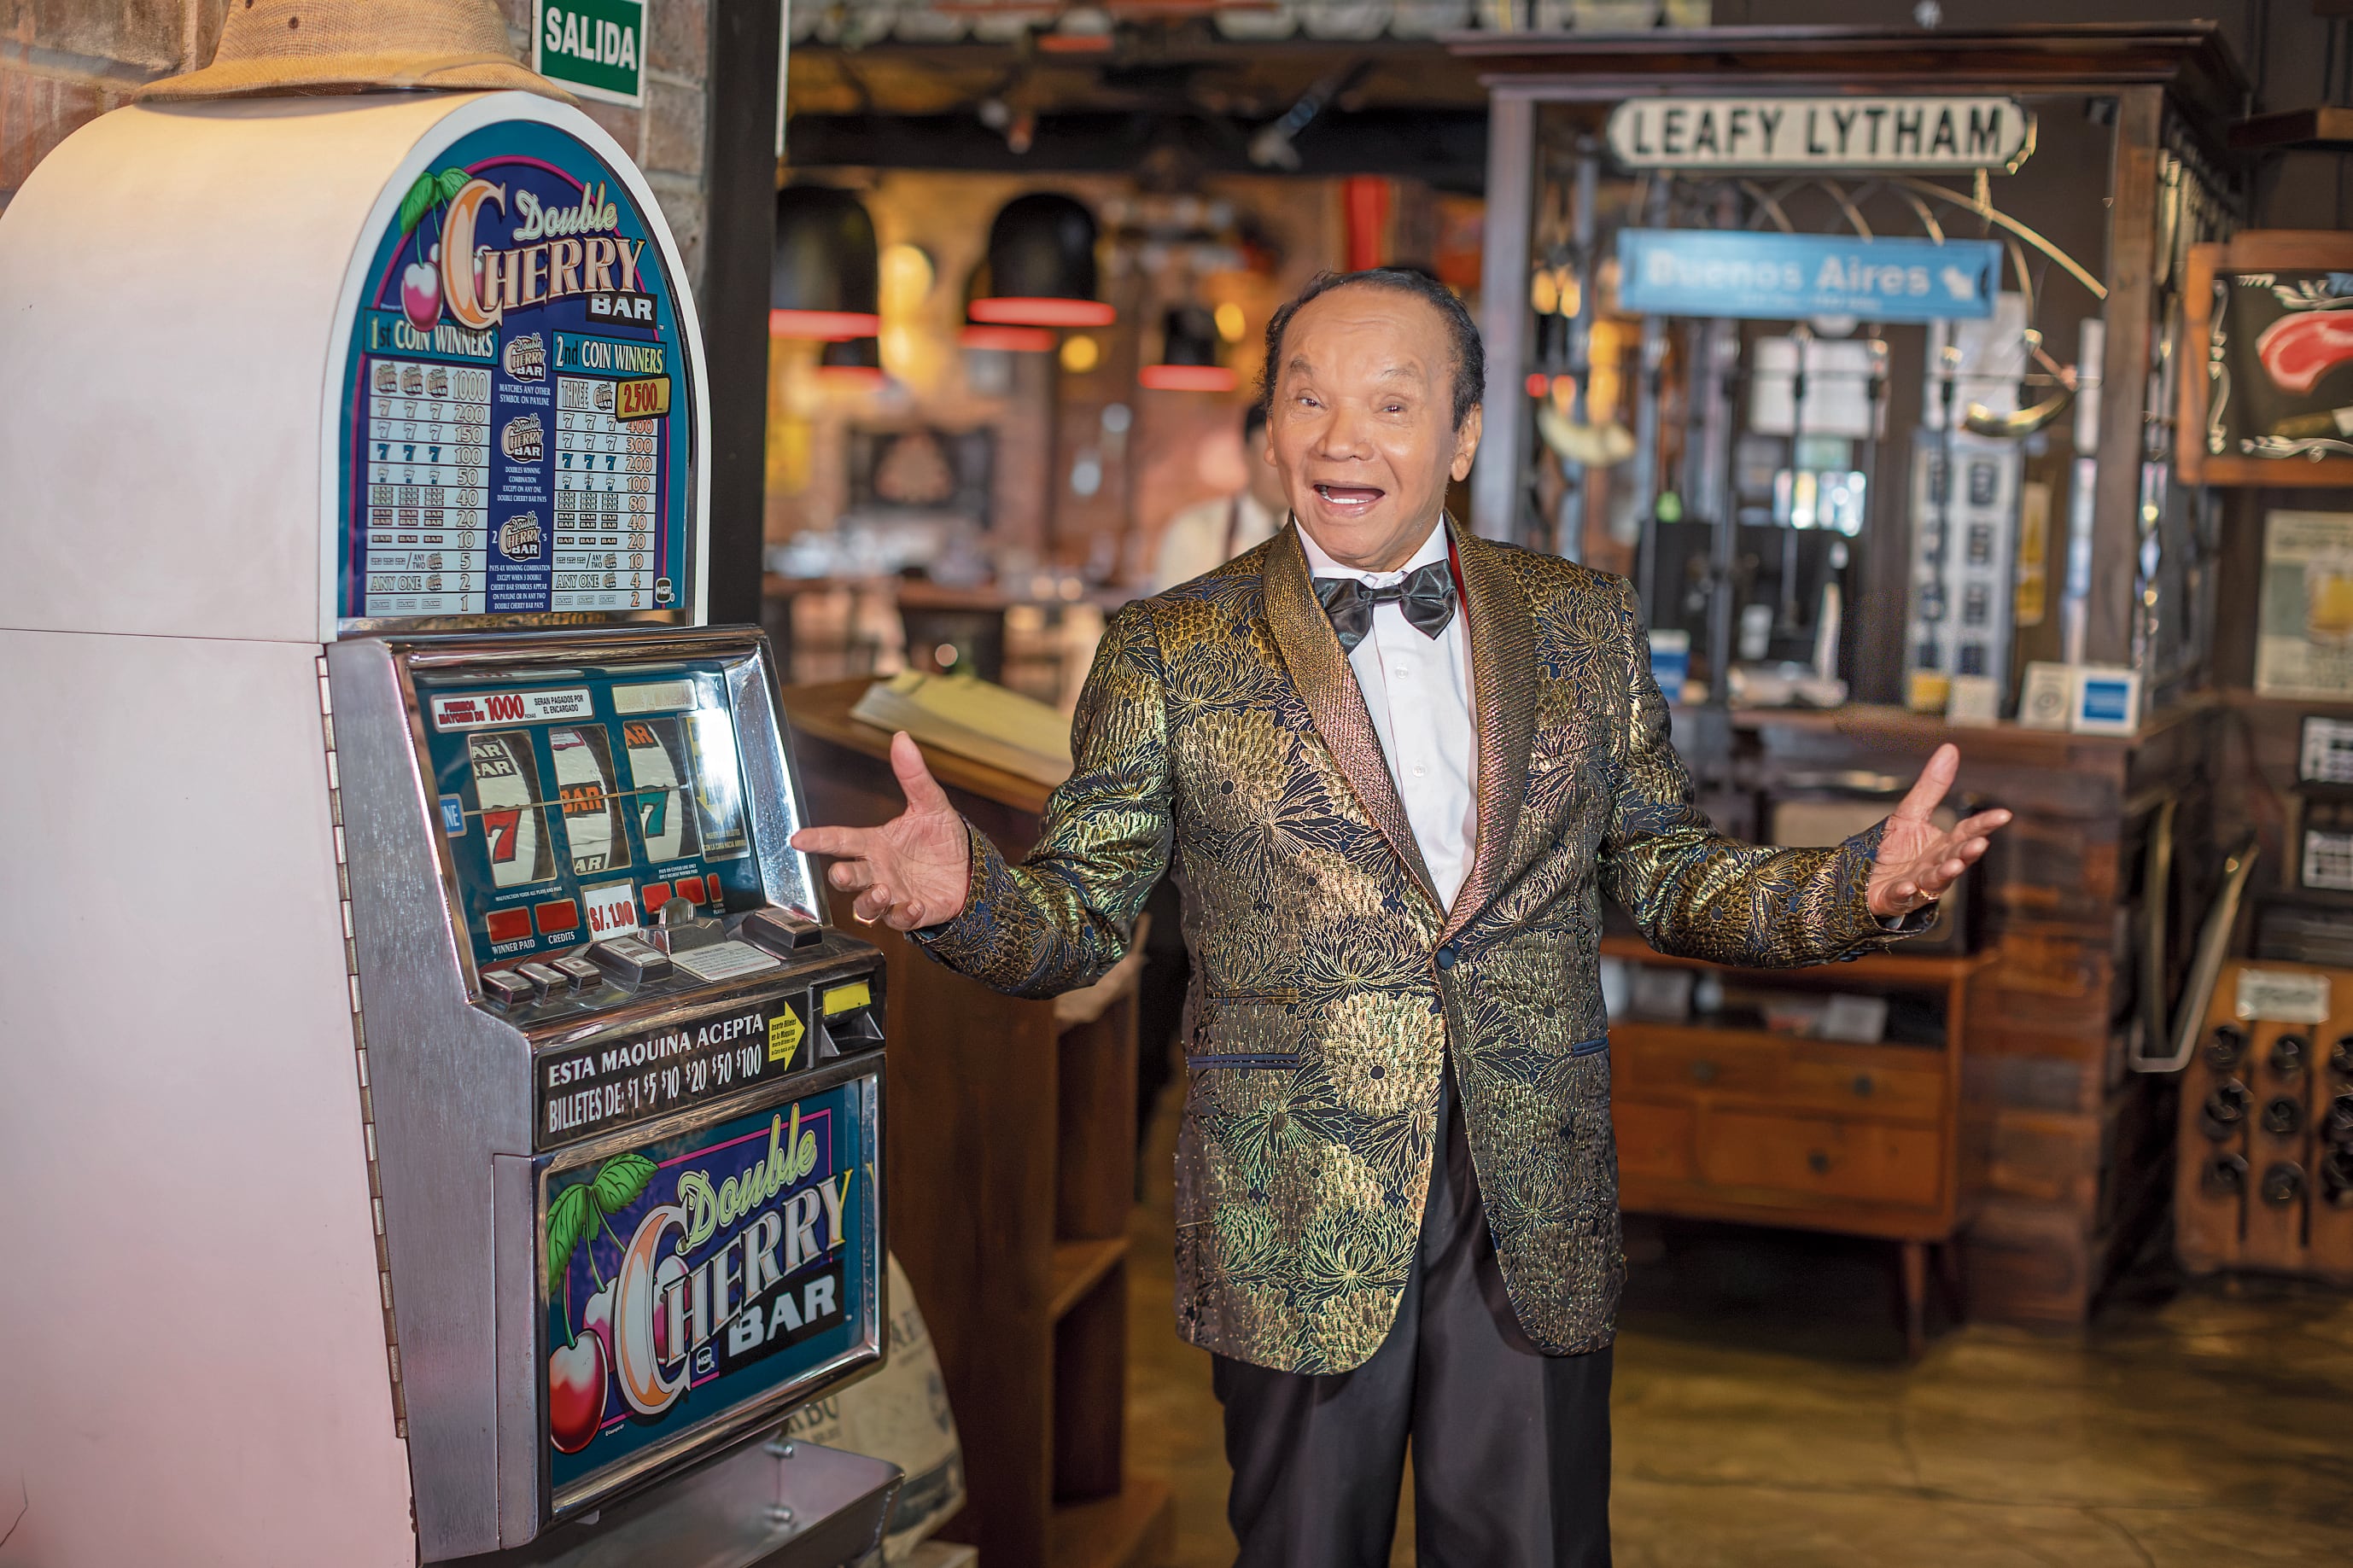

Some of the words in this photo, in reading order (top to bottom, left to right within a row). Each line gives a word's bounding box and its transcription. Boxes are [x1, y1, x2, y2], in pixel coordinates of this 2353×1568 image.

[546, 7, 638, 71] SALIDA
[1633, 107, 1784, 155] LEAFY
[1806, 107, 2004, 156] LYTHAM
[512, 180, 618, 242] Double
[441, 178, 646, 330] CHERRY
[1648, 248, 1803, 291] Buenos
[1817, 255, 1930, 297] Aires
[591, 295, 653, 321] BAR
[371, 316, 391, 350] 1st
[394, 319, 430, 353] COIN
[435, 324, 493, 358] WINNERS
[515, 333, 542, 352] Double
[505, 344, 545, 374] CHERRY
[557, 335, 579, 367] 2nd
[581, 340, 611, 370] COIN
[614, 344, 663, 375] WINNERS
[517, 365, 543, 376] BAR
[452, 370, 488, 402] 1000
[499, 384, 523, 393] MATCHES
[524, 386, 534, 394] ANY
[535, 388, 551, 396] OTHER
[562, 380, 588, 410] THREE
[500, 394, 521, 404] SYMBOL
[530, 397, 550, 406] PAYLINE
[453, 405, 486, 423] 200
[514, 413, 540, 433] Double
[563, 413, 575, 428] 7
[585, 415, 596, 430] 7
[607, 416, 616, 431] 7
[626, 419, 653, 434] 400
[454, 426, 483, 443] 150
[503, 425, 544, 456] CHERRY
[377, 443, 391, 460] 7
[403, 445, 417, 462] 7
[429, 446, 442, 463] 7
[454, 446, 482, 464] 100
[514, 446, 540, 457] BAR
[626, 437, 652, 453] 300
[562, 453, 574, 469] 7
[584, 454, 595, 469] 7
[606, 455, 616, 470] 7
[626, 456, 652, 472] 200
[458, 469, 479, 486] 50
[627, 476, 650, 492] 100
[456, 489, 479, 506] 40
[628, 496, 646, 511] 80
[456, 510, 478, 528] 20
[511, 511, 537, 532] Double
[628, 514, 646, 530] 40
[458, 531, 476, 549] 10
[492, 530, 499, 544] 2
[500, 524, 540, 555] CHERRY
[628, 533, 646, 549] 20
[512, 544, 538, 554] BAR
[460, 552, 471, 570] 5
[629, 553, 644, 569] 10
[371, 576, 395, 591] ANY
[398, 575, 422, 591] ONE
[459, 574, 470, 591] 2
[556, 574, 577, 589] ANY
[579, 574, 599, 588] ONE
[630, 573, 640, 588] 4
[461, 594, 469, 611] 1
[631, 592, 640, 607] 2
[485, 695, 524, 721] 1000
[534, 697, 551, 706] SERAN
[552, 695, 574, 705] PAGADOS
[574, 694, 584, 702] POR
[543, 706, 550, 714] EL
[550, 704, 579, 714] ENCARGADO
[623, 725, 654, 746] AR
[472, 743, 500, 759] AR
[560, 786, 603, 813] BAR
[637, 790, 669, 838] 7
[483, 809, 522, 864] 7
[574, 854, 602, 873] AR
[492, 942, 519, 955] WINNER
[518, 939, 535, 951] PAID
[548, 931, 575, 945] CREDITS
[771, 1021, 783, 1031] Inserte
[784, 1018, 797, 1028] Billetes
[780, 1029, 796, 1038] Maquina
[548, 1056, 596, 1088] ESTA
[601, 1031, 692, 1074] MAQUINA
[696, 1013, 765, 1048] ACEPTA
[548, 1083, 602, 1134] BILLETES
[604, 1081, 625, 1118] DE:
[628, 1077, 639, 1109] $1
[644, 1072, 657, 1105] $5
[662, 1065, 680, 1099] $10
[686, 1058, 707, 1093] $20
[712, 1050, 733, 1086] $50
[736, 1043, 762, 1079] $100
[676, 1102, 818, 1256] Double
[614, 1167, 854, 1415] CHERRY
[728, 1274, 838, 1359] BAR
